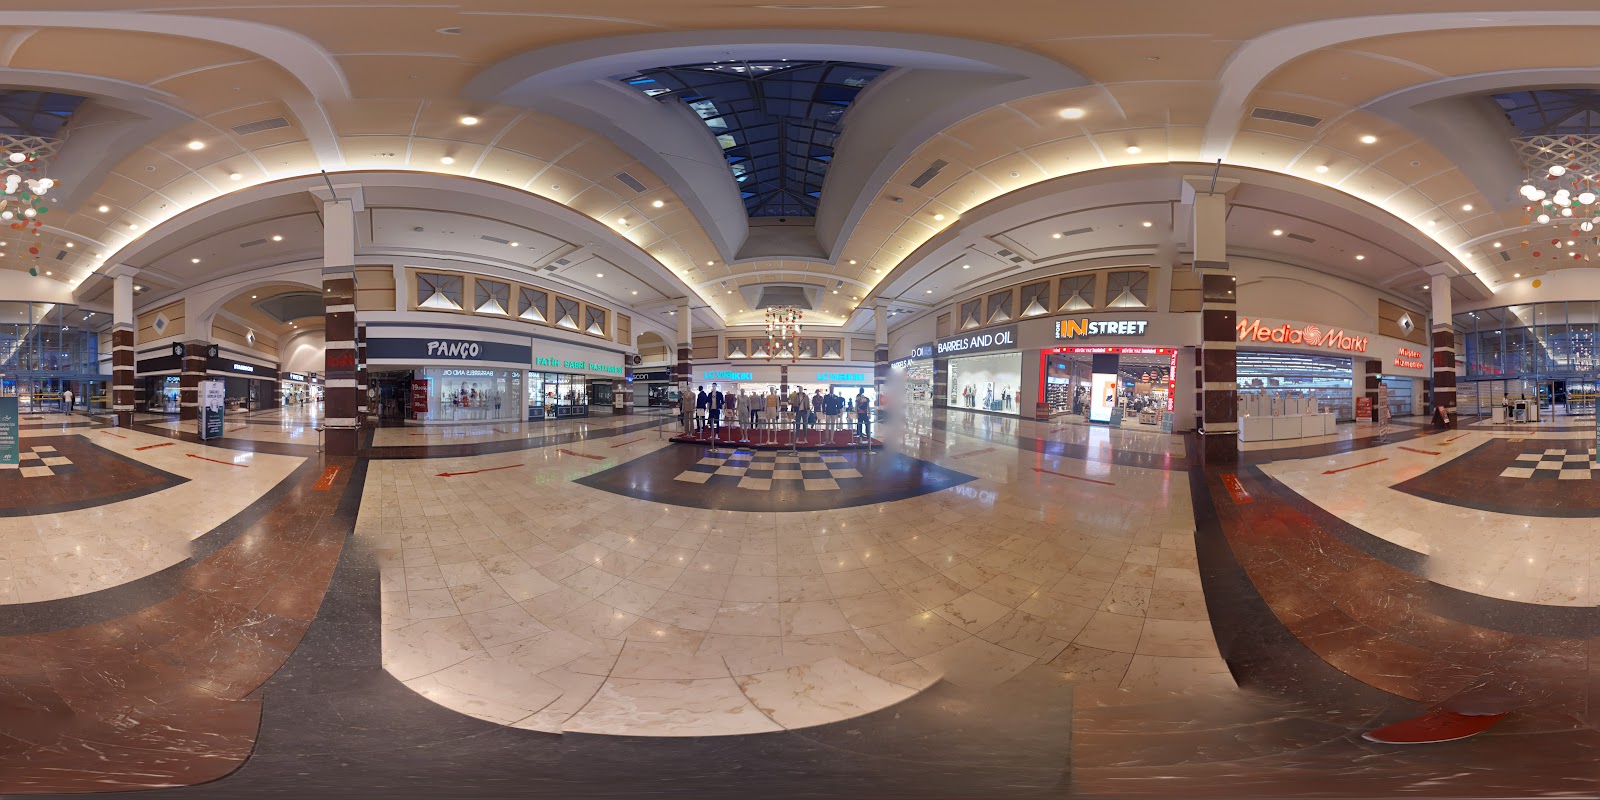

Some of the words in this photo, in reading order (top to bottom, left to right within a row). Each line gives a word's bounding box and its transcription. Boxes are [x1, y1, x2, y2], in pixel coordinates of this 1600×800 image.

[1061, 319, 1088, 338] IN
[1088, 321, 1147, 335] STREET
[1236, 318, 1303, 344] Media
[1319, 328, 1368, 352] Markt
[427, 341, 479, 359] PANÇO
[938, 339, 969, 354] BARRELS
[969, 335, 992, 349] AND
[995, 331, 1013, 346] OIL
[1399, 347, 1421, 359] Müşteri
[536, 357, 560, 368] FATİH
[564, 361, 586, 371] SABRİ
[1394, 358, 1424, 370] Hizmetleri
